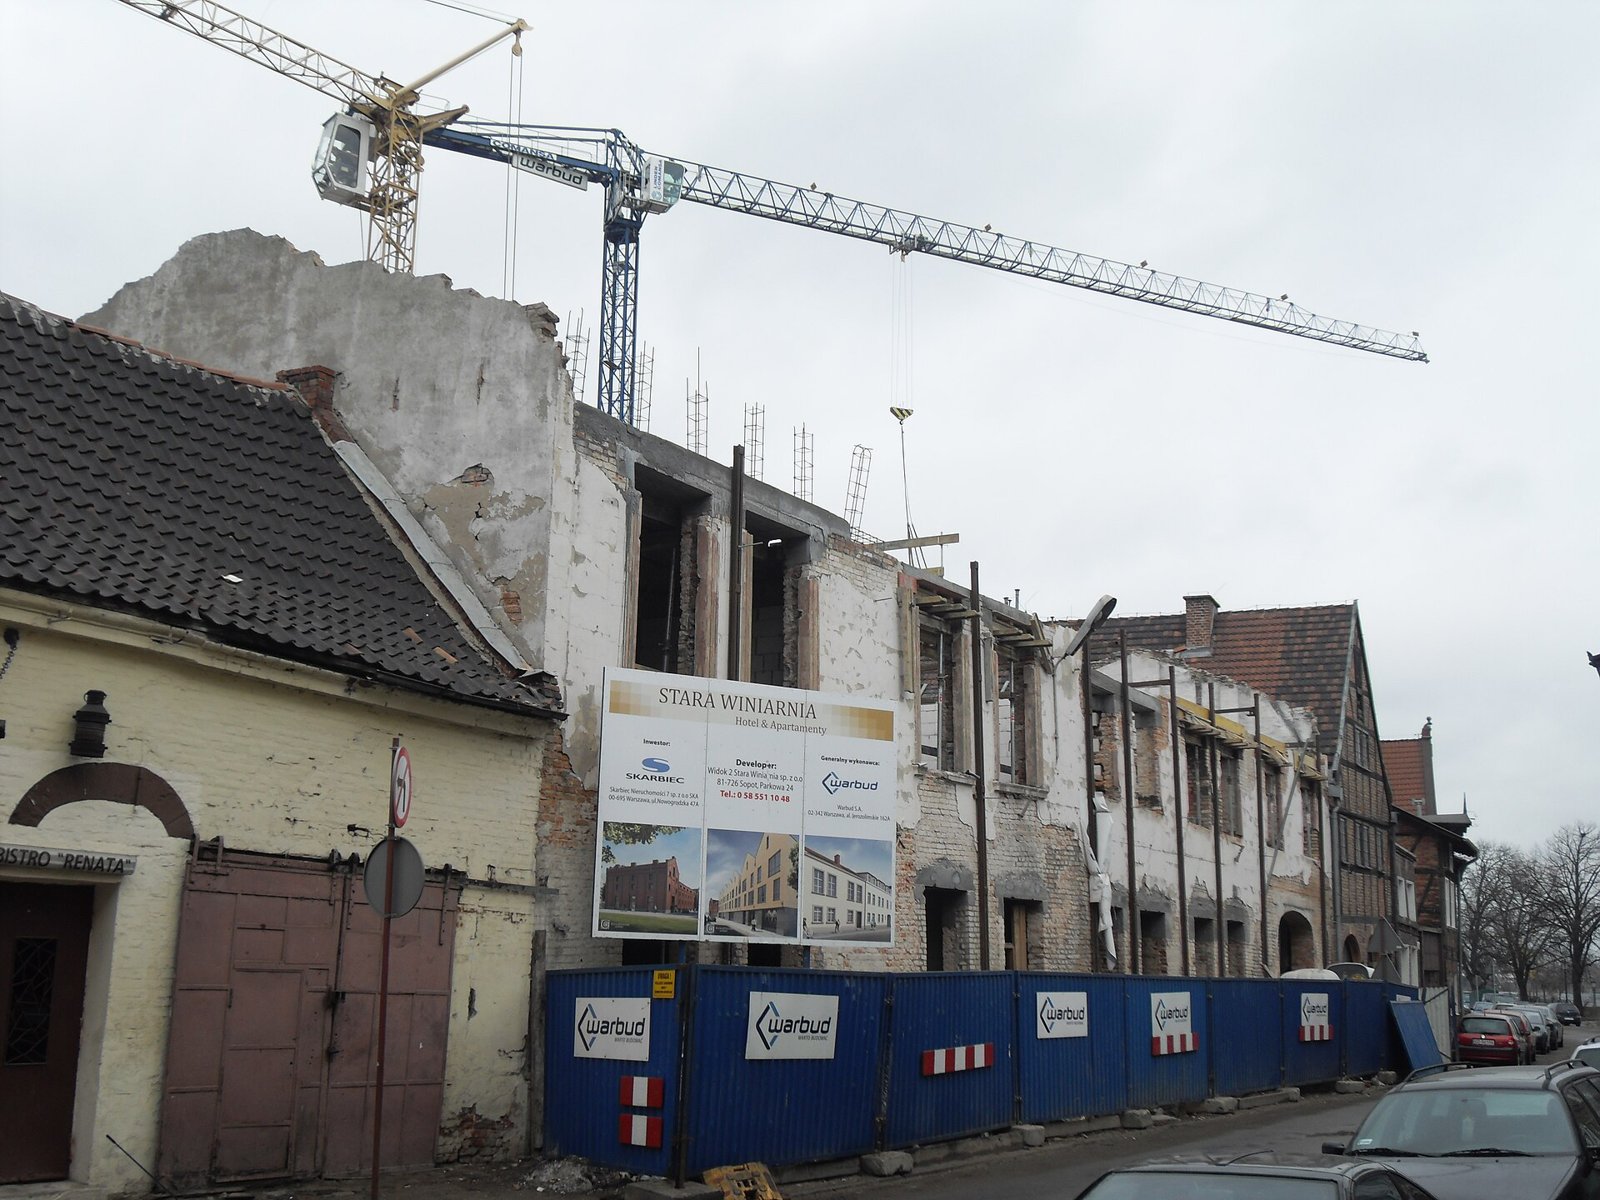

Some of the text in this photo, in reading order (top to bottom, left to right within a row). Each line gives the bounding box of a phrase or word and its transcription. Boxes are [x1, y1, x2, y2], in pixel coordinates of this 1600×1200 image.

[493, 139, 556, 161] COMANSA
[519, 156, 583, 185] warbud
[658, 687, 817, 720] STARA WINIARNIA
[735, 716, 828, 736] Hotel & Apartamenty
[643, 738, 671, 747] Inwestor:
[821, 755, 880, 766] Generalny wykonawca:
[625, 772, 685, 784] SKARBIEC
[707, 766, 727, 775] Widok
[728, 768, 733, 776] 2
[734, 769, 749, 778] Stara
[750, 770, 779, 780] Winiania
[609, 786, 630, 794] Skarbiec
[716, 778, 794, 792] 81-726 Sopot, Parkowa 24
[830, 779, 879, 791] warbud
[720, 790, 790, 803] Tel.: 0 58 551 10 48
[0, 847, 131, 873] BISTRO "RENATA"
[1046, 1006, 1085, 1020] warbud
[1160, 1005, 1188, 1020] warbud
[586, 1017, 646, 1036] warbud
[768, 1016, 832, 1034] warbud
